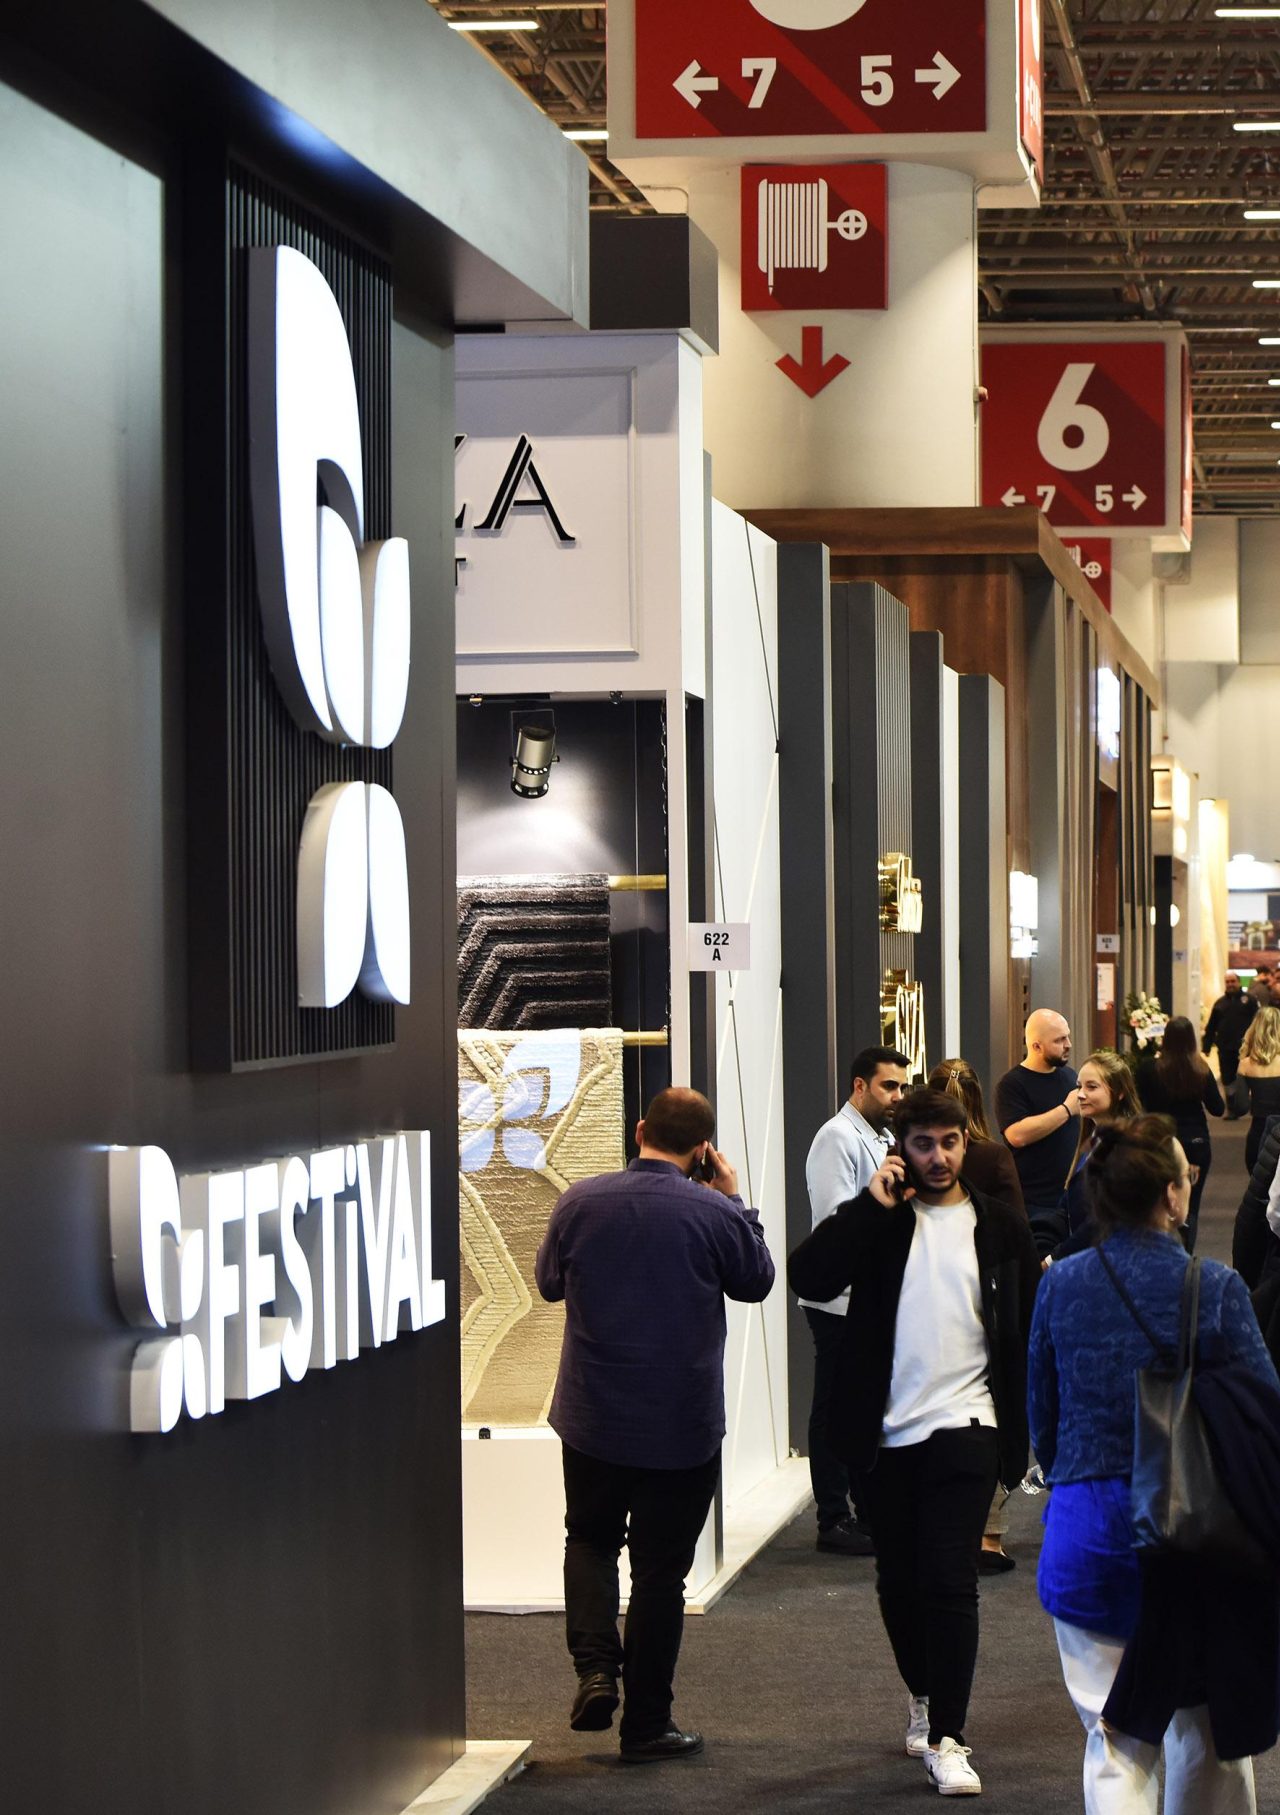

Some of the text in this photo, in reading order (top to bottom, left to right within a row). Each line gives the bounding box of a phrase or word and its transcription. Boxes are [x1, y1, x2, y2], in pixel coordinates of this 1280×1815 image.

[741, 54, 894, 109] 7 5
[1037, 362, 1110, 473] 6
[1036, 484, 1114, 513] 7 5
[704, 932, 730, 946] 622
[712, 948, 721, 961] A
